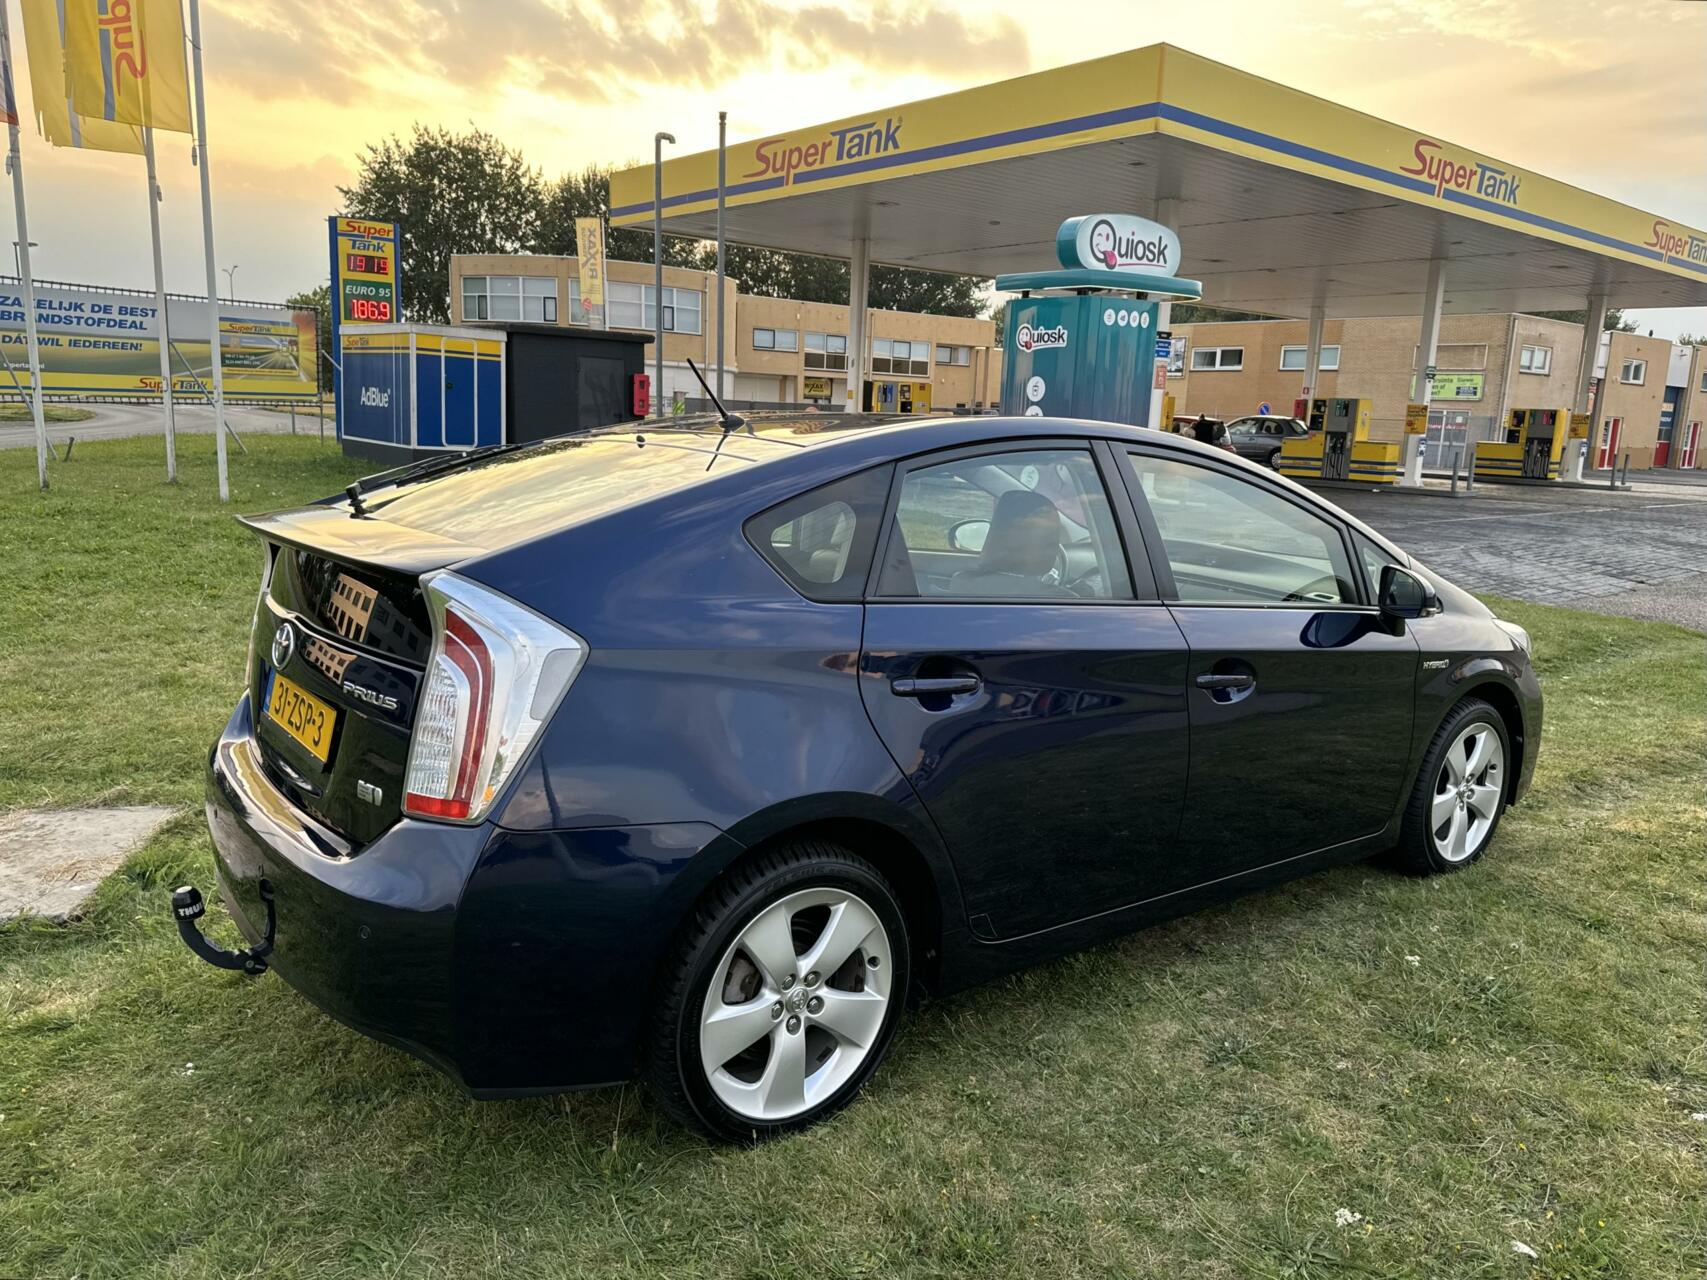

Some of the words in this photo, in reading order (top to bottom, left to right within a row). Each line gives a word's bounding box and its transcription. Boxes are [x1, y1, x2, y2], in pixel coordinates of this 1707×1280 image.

[742, 118, 902, 187] SuperTank
[1399, 139, 1521, 205] SuperTank
[339, 220, 395, 239] Super
[347, 238, 386, 253] Tank
[1090, 219, 1168, 270] Quiosk
[345, 285, 376, 296] EURO
[378, 287, 392, 298] 95
[0, 295, 86, 313] ZAELIJK
[90, 303, 113, 315] DE
[118, 305, 158, 318] BEST
[352, 299, 391, 320] 186.9
[0, 310, 148, 331] BRNDSTOFDEAL
[37, 336, 64, 347] WIL
[68, 339, 143, 352] IEDEREEN!
[1017, 325, 1066, 350] Quiosk
[134, 377, 208, 394] SuprTank
[342, 681, 399, 710] PRIUS
[274, 681, 325, 747] 31-ZSP-3
